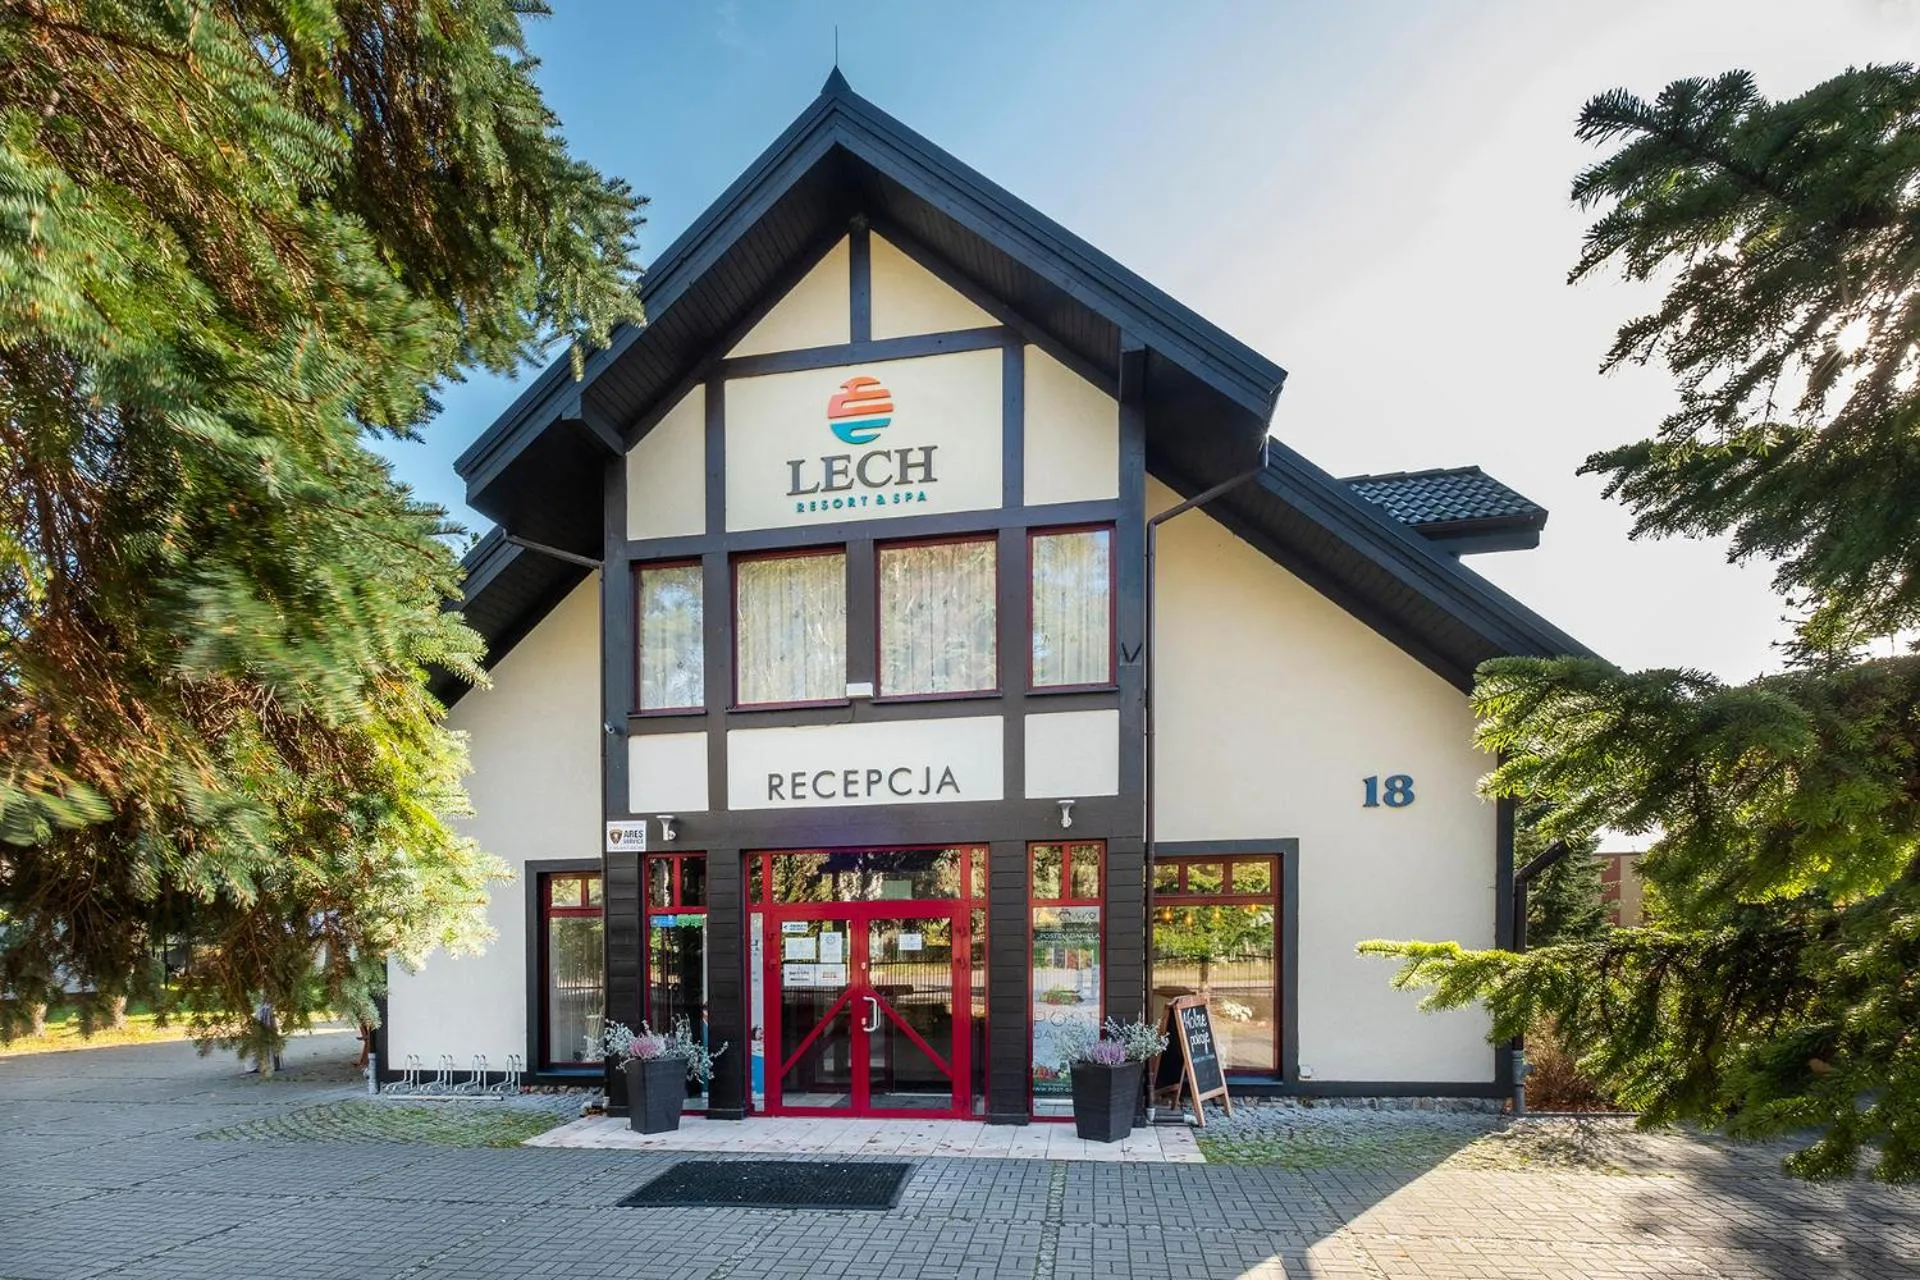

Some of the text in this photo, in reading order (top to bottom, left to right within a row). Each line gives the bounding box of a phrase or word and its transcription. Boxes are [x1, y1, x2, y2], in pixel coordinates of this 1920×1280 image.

[786, 445, 938, 496] LECH
[796, 490, 927, 513] RESORT & SPA
[767, 765, 961, 801] RECEPCJA
[1362, 774, 1415, 808] 18
[623, 830, 644, 839] ARES
